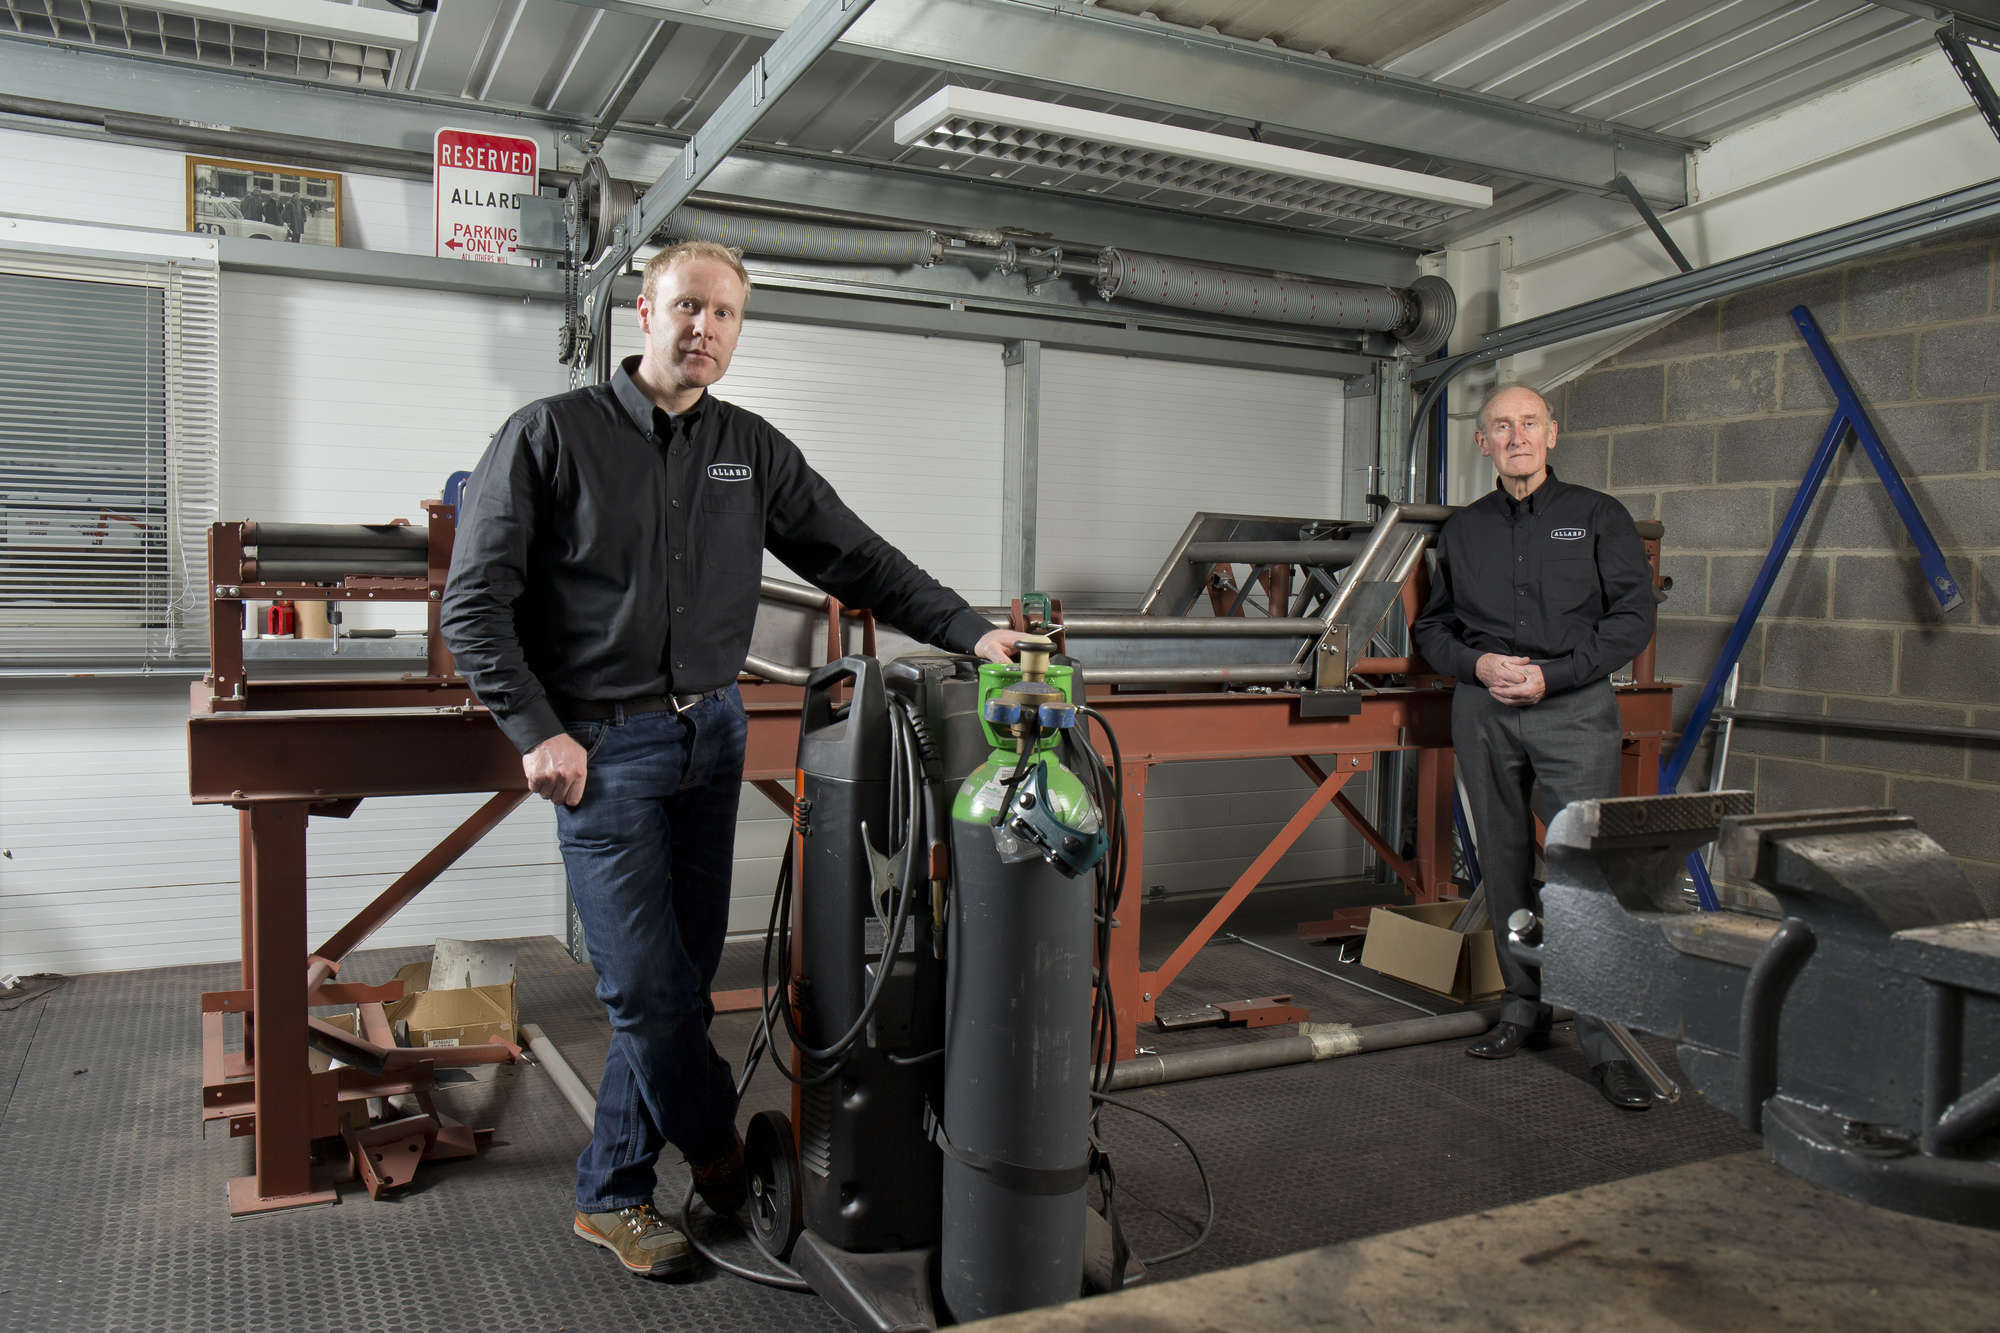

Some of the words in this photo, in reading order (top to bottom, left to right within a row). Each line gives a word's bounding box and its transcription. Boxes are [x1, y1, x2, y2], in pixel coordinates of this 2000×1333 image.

[442, 143, 532, 174] RESERVED
[451, 187, 520, 210] ALLARD
[453, 223, 518, 242] PARKING
[466, 238, 504, 254] ONLY
[712, 468, 748, 477] ALLARD
